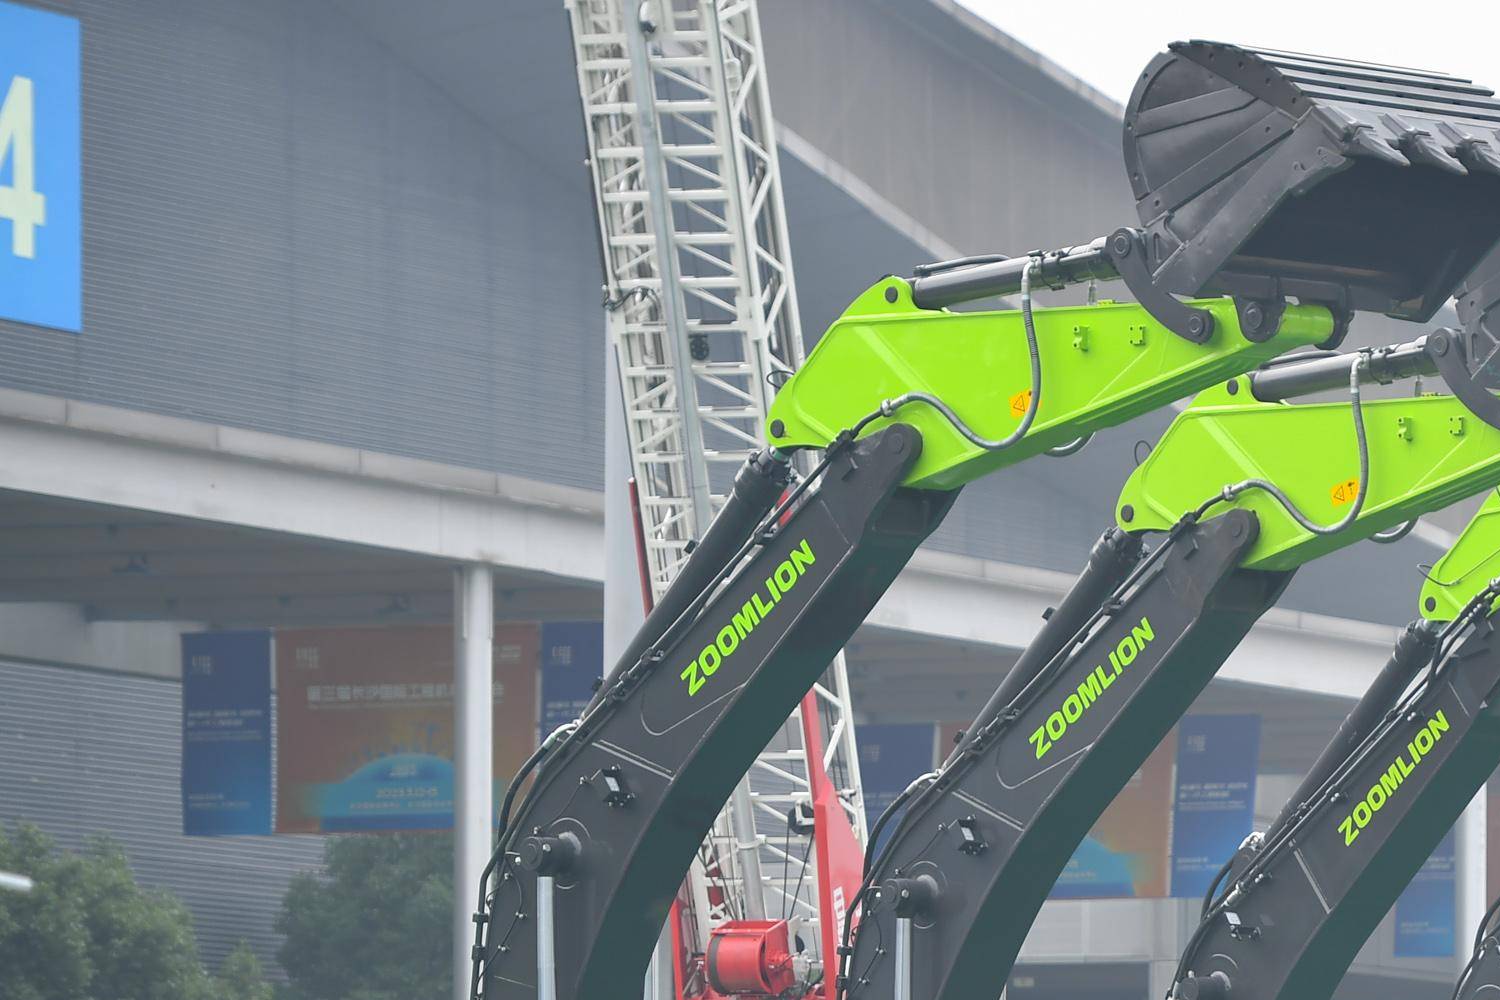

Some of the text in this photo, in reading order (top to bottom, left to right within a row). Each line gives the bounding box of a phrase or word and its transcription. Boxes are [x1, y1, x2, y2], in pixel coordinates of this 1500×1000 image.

[0, 75, 46, 259] 4
[682, 539, 816, 696] ZOOMLION
[1029, 618, 1155, 759] ZOOMLION
[1338, 711, 1450, 846] ZOOMLION
